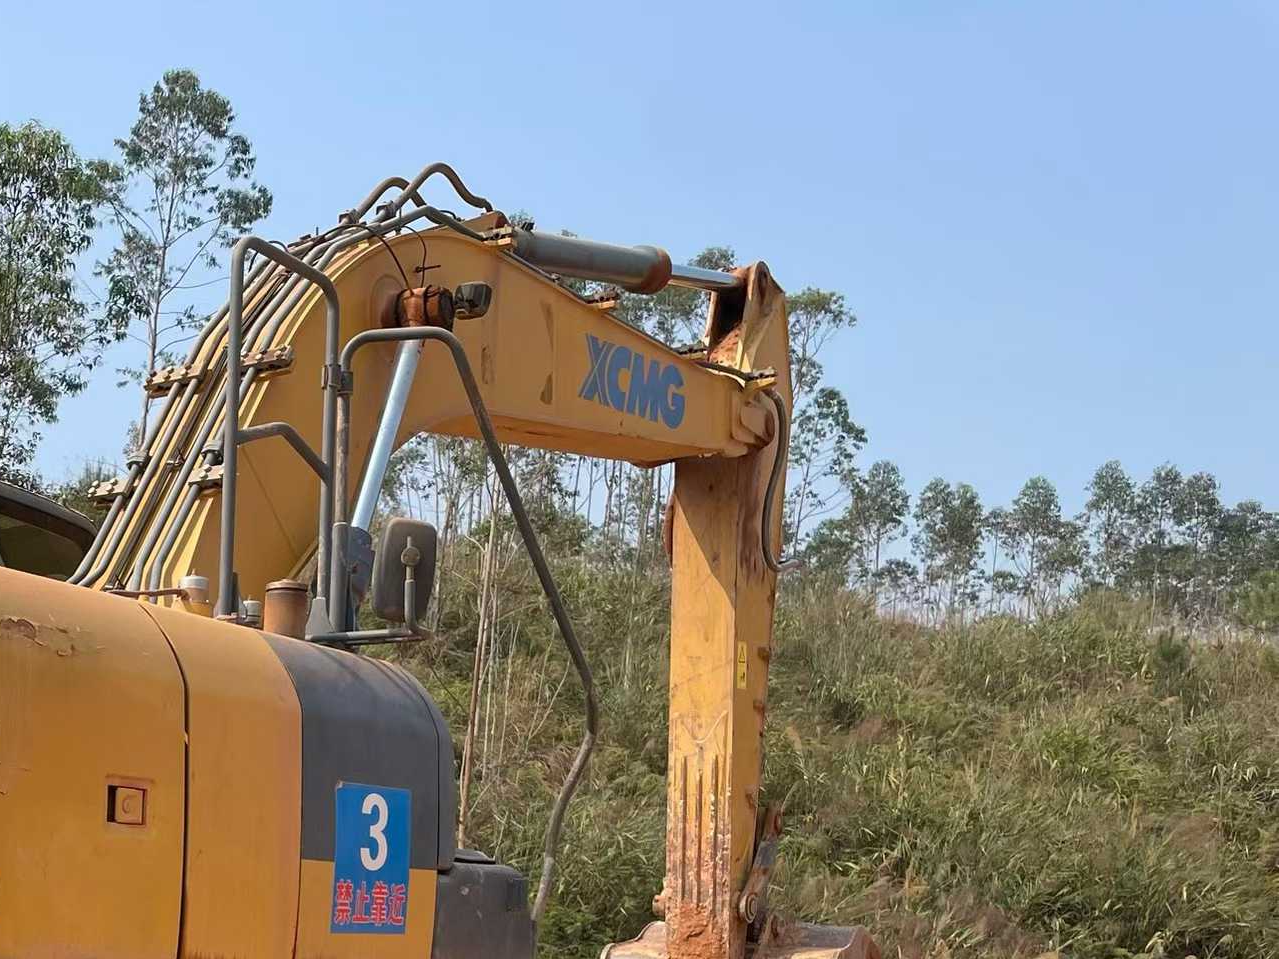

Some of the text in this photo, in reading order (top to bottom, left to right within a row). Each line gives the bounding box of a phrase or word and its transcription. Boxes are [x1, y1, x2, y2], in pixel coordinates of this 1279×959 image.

[579, 333, 685, 429] XCMG
[360, 793, 389, 871] 3
[334, 879, 406, 926] 禁止靠近
